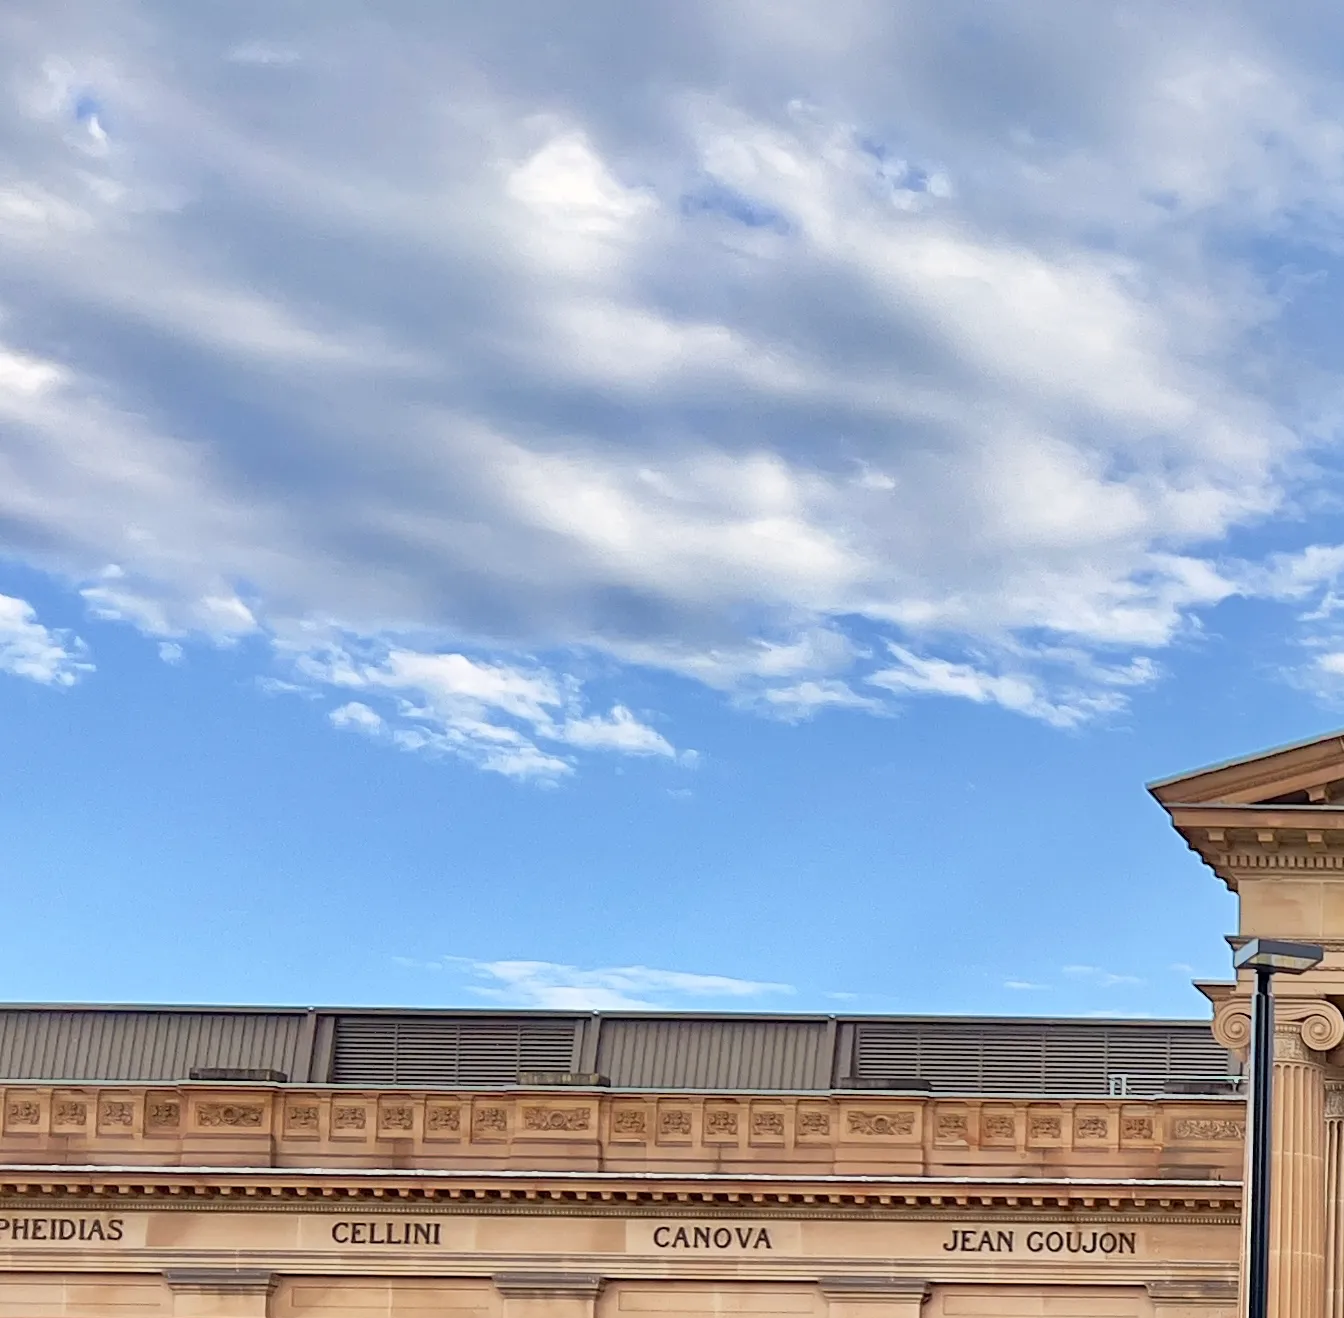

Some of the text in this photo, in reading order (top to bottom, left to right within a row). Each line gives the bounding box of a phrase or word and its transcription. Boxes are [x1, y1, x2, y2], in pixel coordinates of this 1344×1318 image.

[0, 1218, 124, 1241] PHEIDIAS
[331, 1221, 441, 1245] CELLINI
[653, 1226, 772, 1250] CANOVA
[942, 1229, 1137, 1254] JEAN GOUJON
